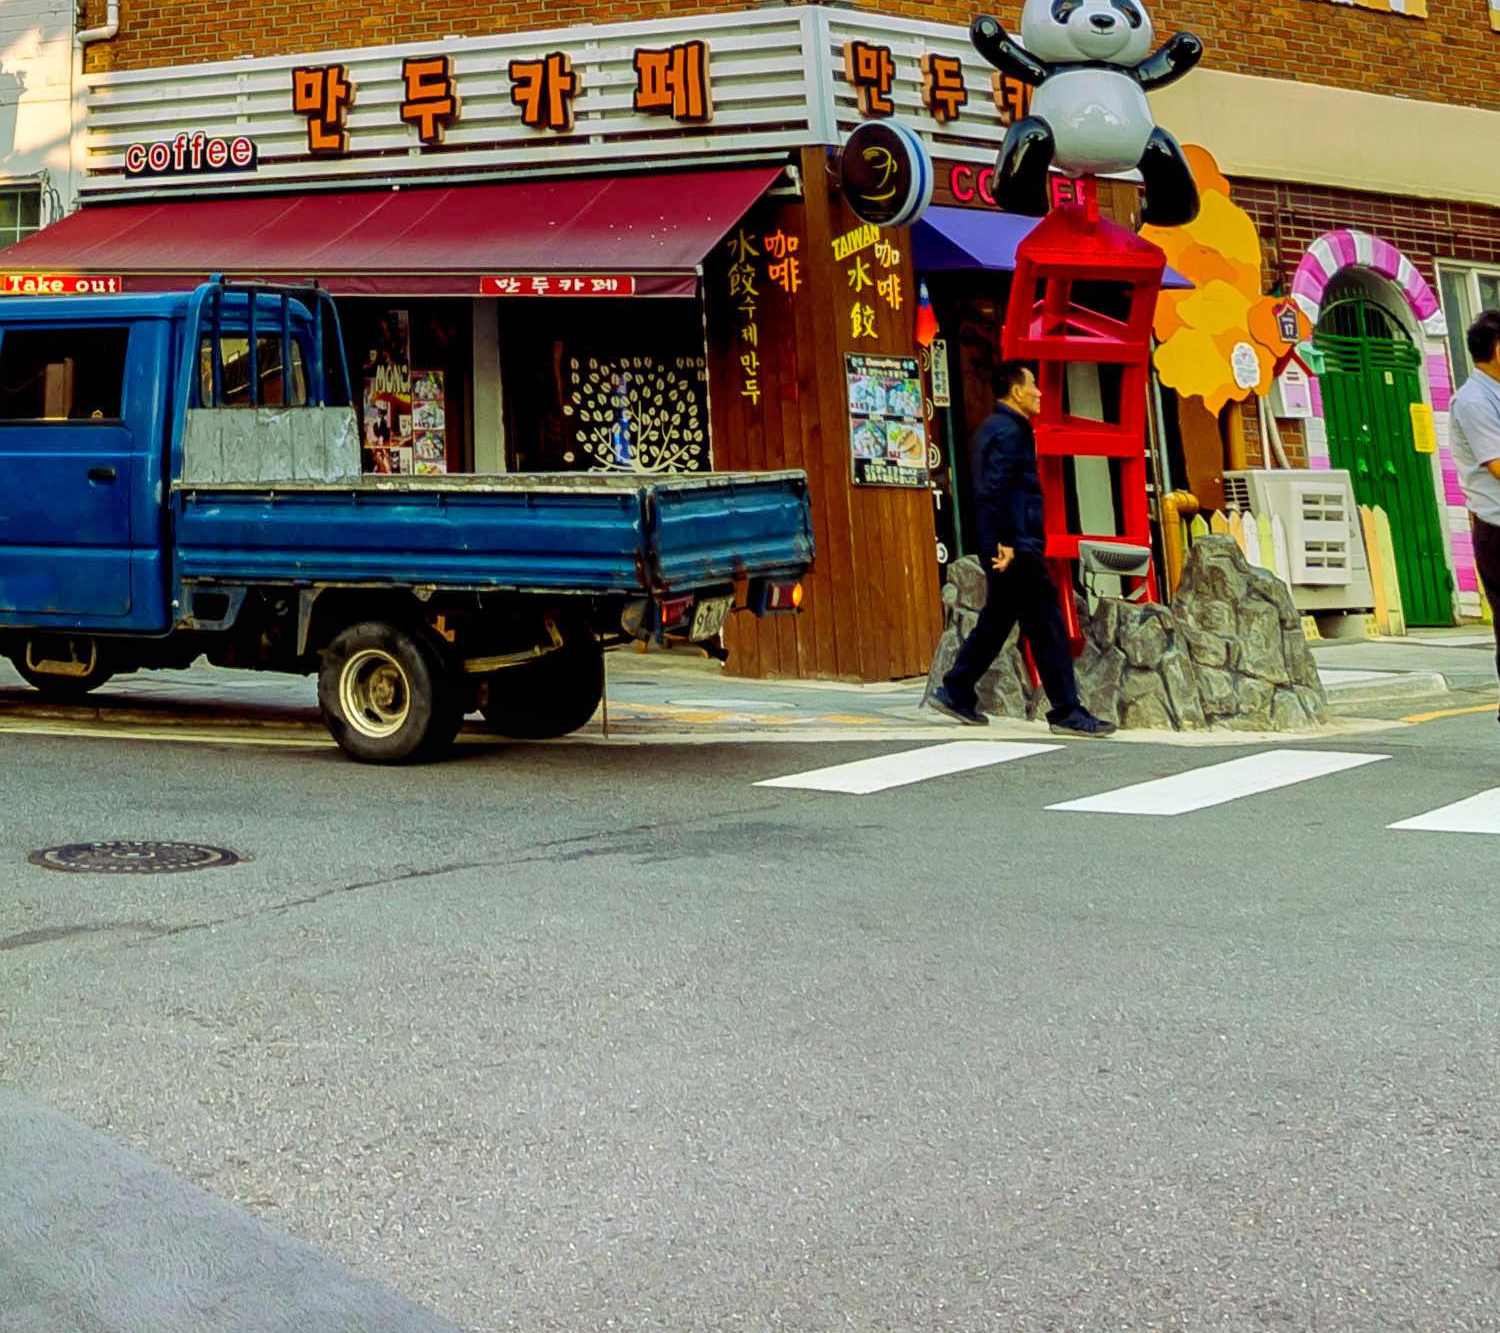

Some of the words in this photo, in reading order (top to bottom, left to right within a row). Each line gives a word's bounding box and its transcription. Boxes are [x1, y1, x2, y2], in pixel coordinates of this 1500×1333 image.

[293, 40, 711, 155] 만두카페
[125, 130, 256, 175] coffee
[831, 224, 881, 261] TAIWAN
[8, 275, 64, 292] Take
[75, 277, 116, 293] out
[494, 276, 618, 295] 만두카페
